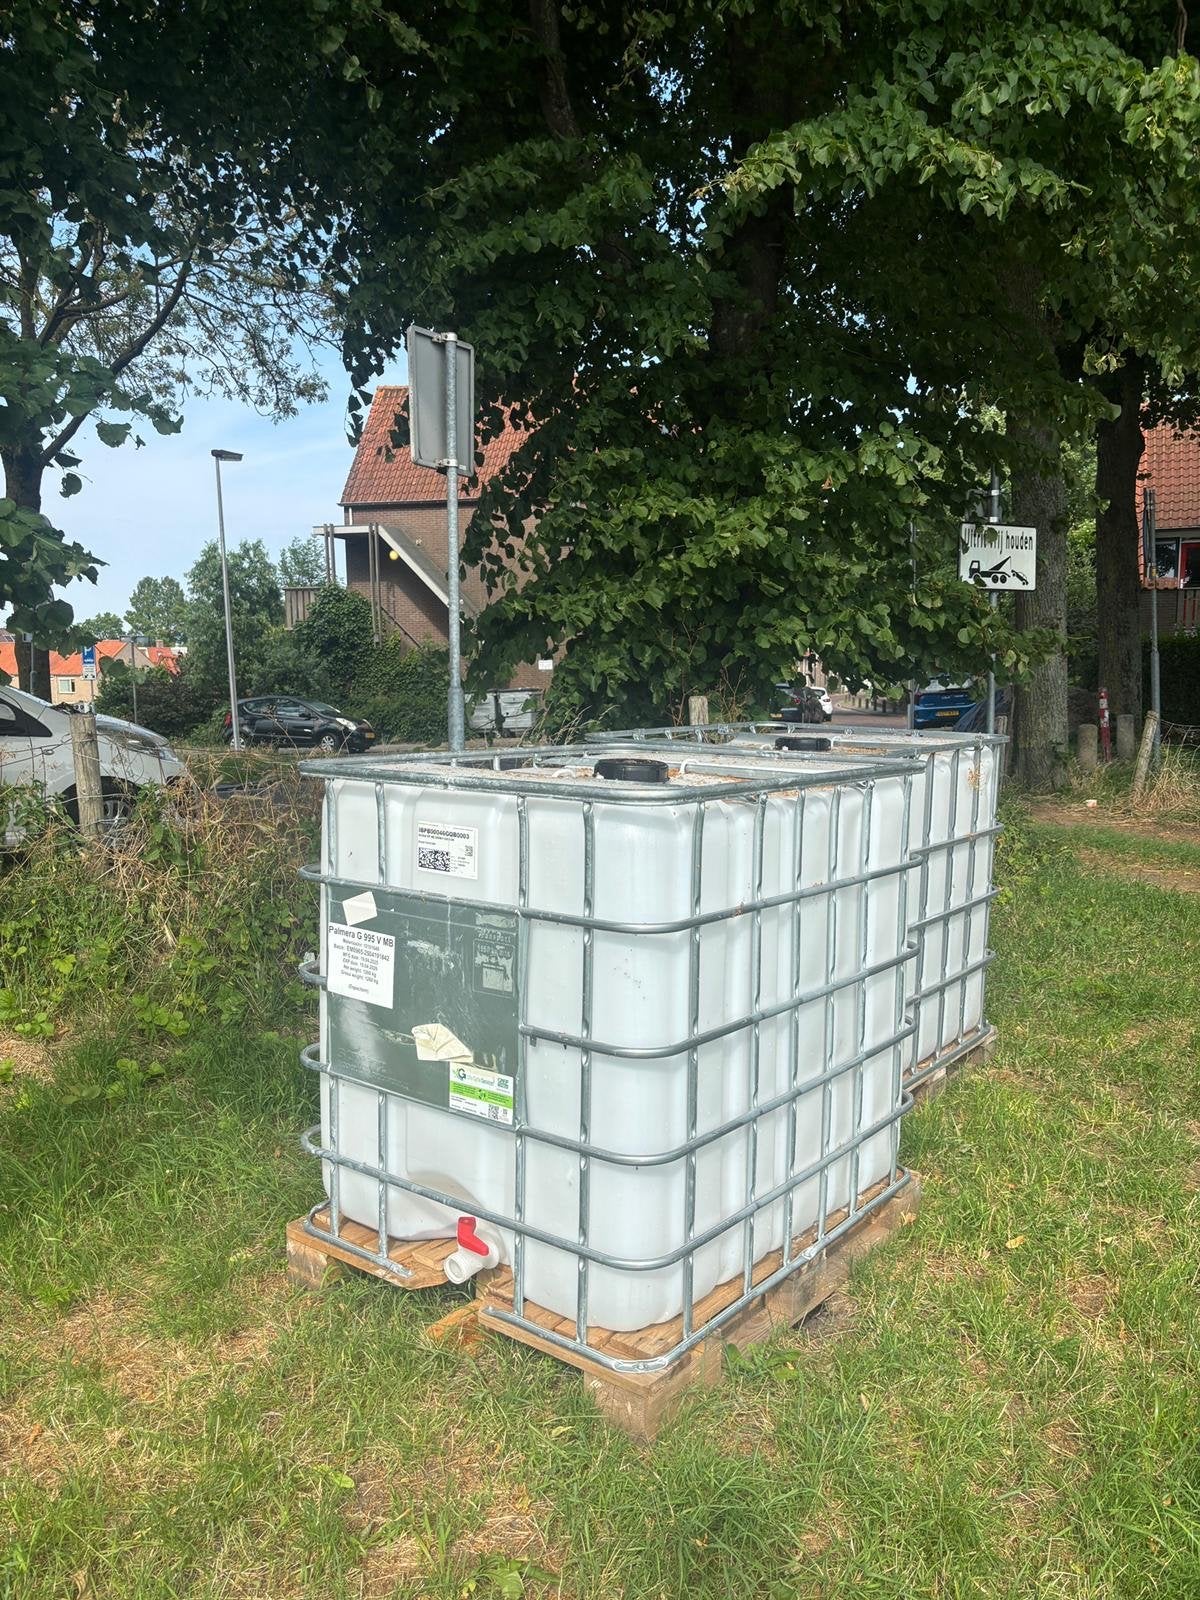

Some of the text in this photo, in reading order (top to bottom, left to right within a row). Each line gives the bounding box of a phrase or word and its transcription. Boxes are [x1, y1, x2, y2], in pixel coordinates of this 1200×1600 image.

[1006, 530, 1033, 551] houden
[328, 925, 356, 939] Palmera
[356, 931, 363, 939] G
[363, 933, 376, 944] 995
[376, 935, 382, 944] V
[383, 937, 394, 948] MB
